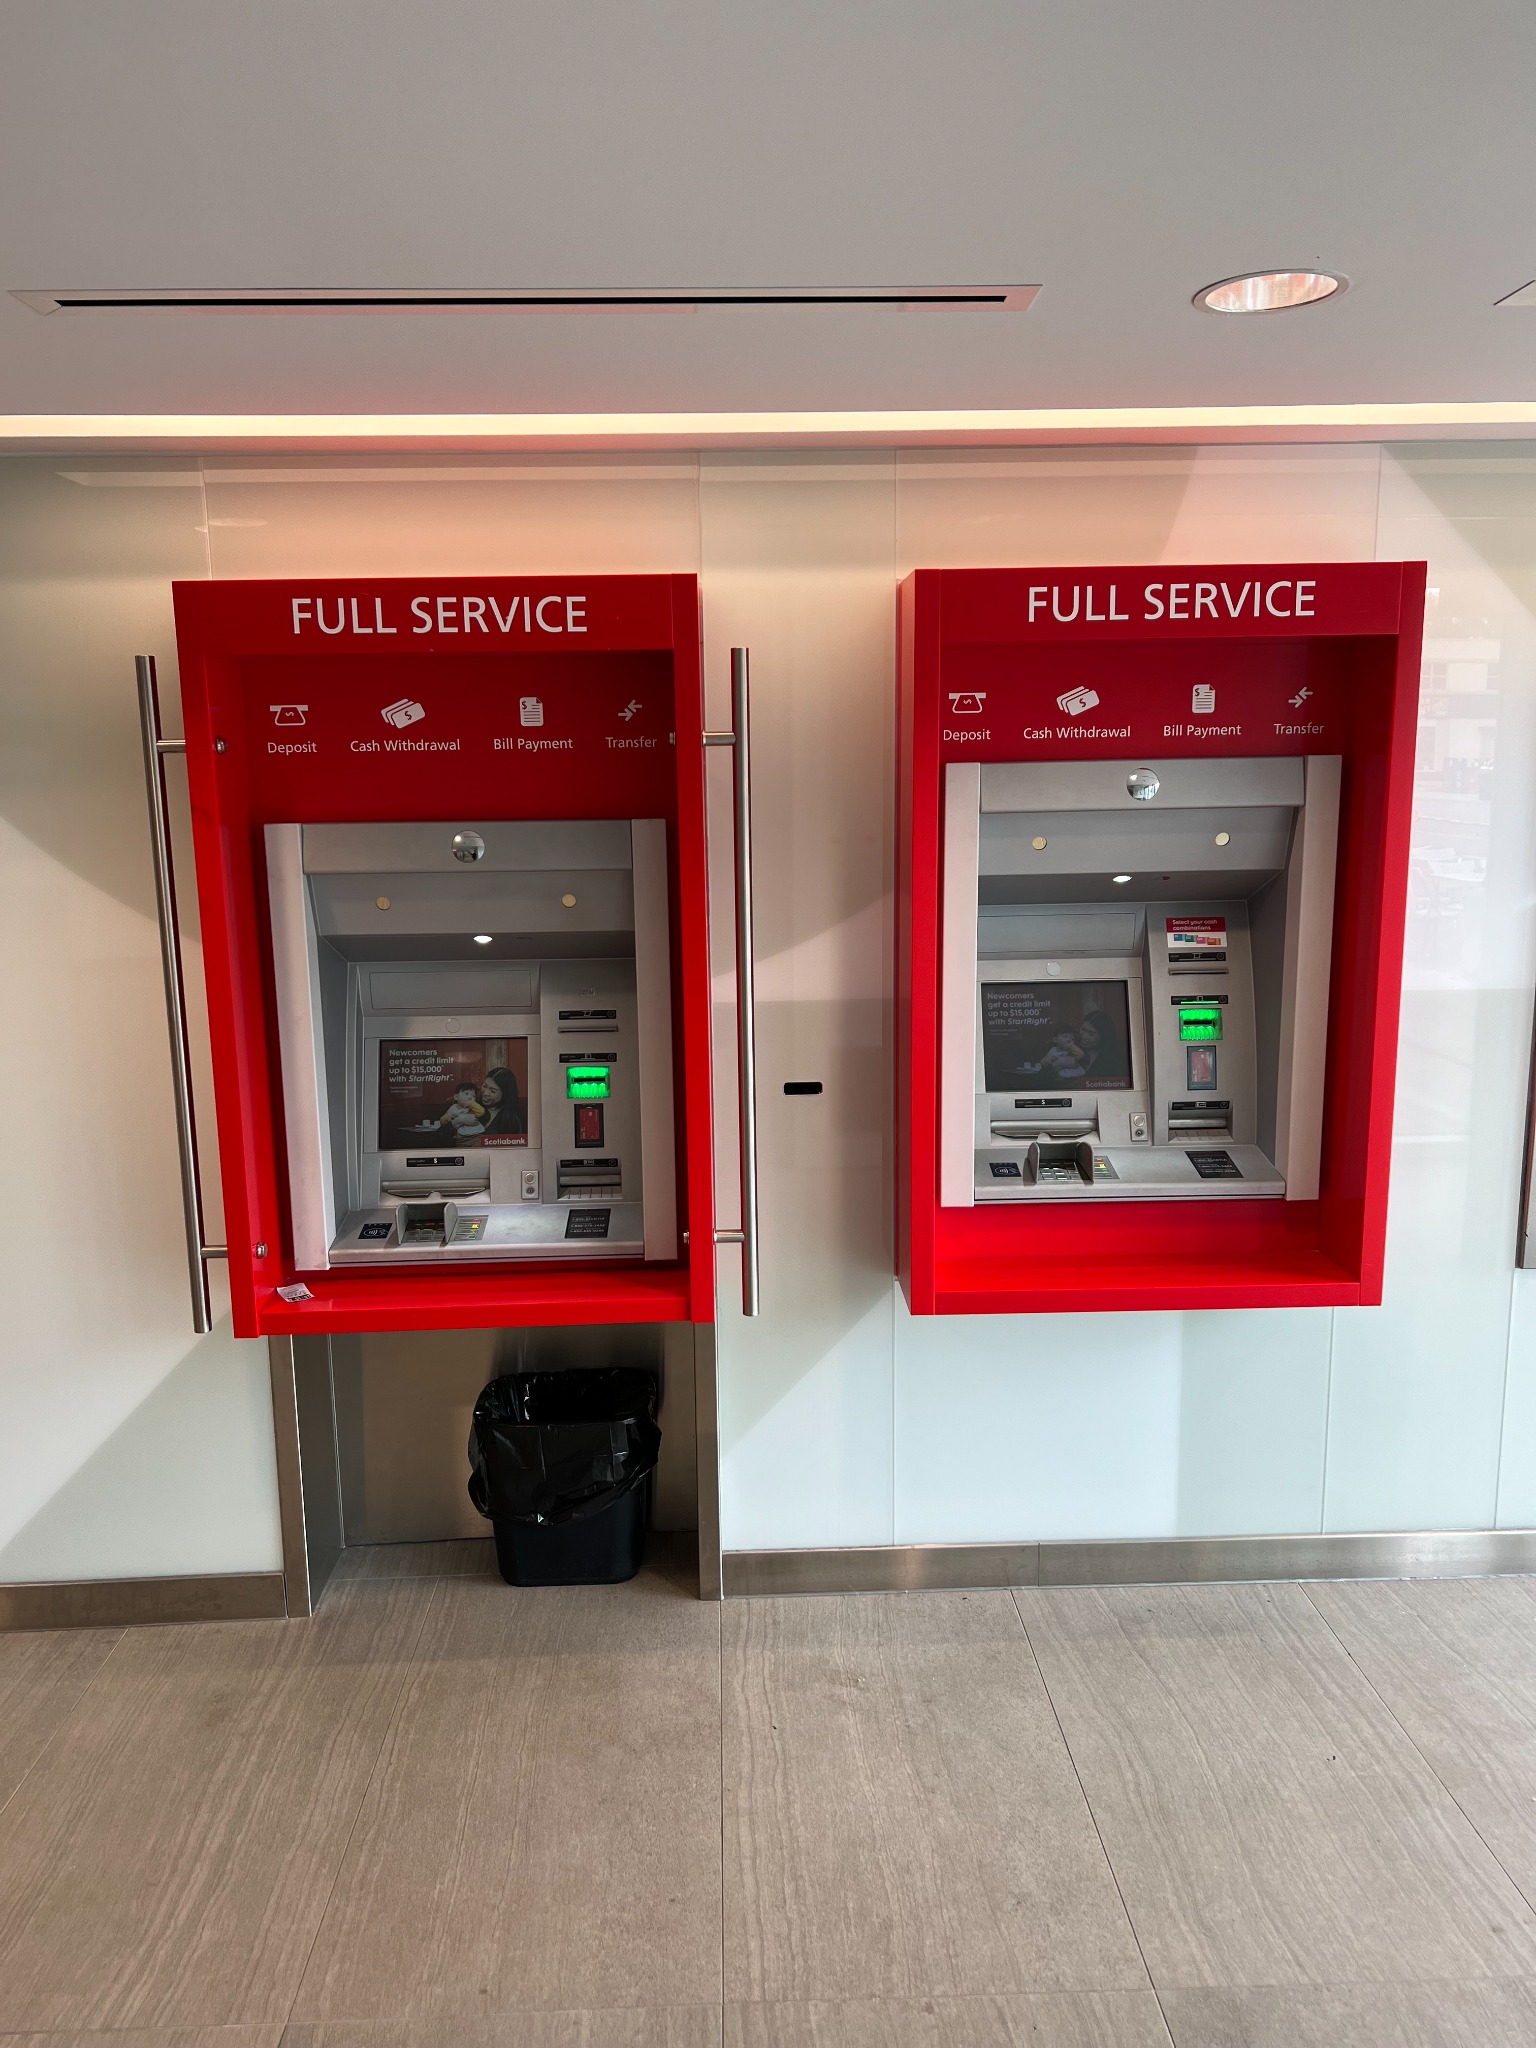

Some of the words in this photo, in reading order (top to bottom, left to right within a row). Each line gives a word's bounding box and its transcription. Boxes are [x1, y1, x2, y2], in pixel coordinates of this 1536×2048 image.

[1027, 584, 1130, 624] FULL
[1143, 580, 1317, 622] SERVICE
[291, 597, 398, 636] FULL
[410, 595, 588, 635] SERVICE
[1022, 726, 1053, 740] Cash
[1055, 724, 1131, 739] Withdrawal
[1162, 724, 1183, 737] Bill
[1186, 724, 1242, 739] Payment
[1273, 722, 1325, 735] Transfer
[605, 735, 658, 749] Transfer
[942, 728, 991, 744] Deposit
[266, 740, 318, 756] Deposit
[349, 738, 381, 752] Cash
[383, 738, 461, 752] Withdrawal
[492, 737, 513, 750] Bill
[517, 737, 574, 753] Payment
[987, 1001, 1001, 1010] get
[1009, 1000, 1032, 1008] credit
[988, 1018, 1006, 1026] with
[389, 1058, 403, 1067] get
[411, 1057, 435, 1065] credit
[436, 1056, 454, 1064] limit
[389, 1075, 407, 1083] with
[1085, 1080, 1127, 1088] Scotiabank
[484, 1137, 526, 1146] Scotiabank
